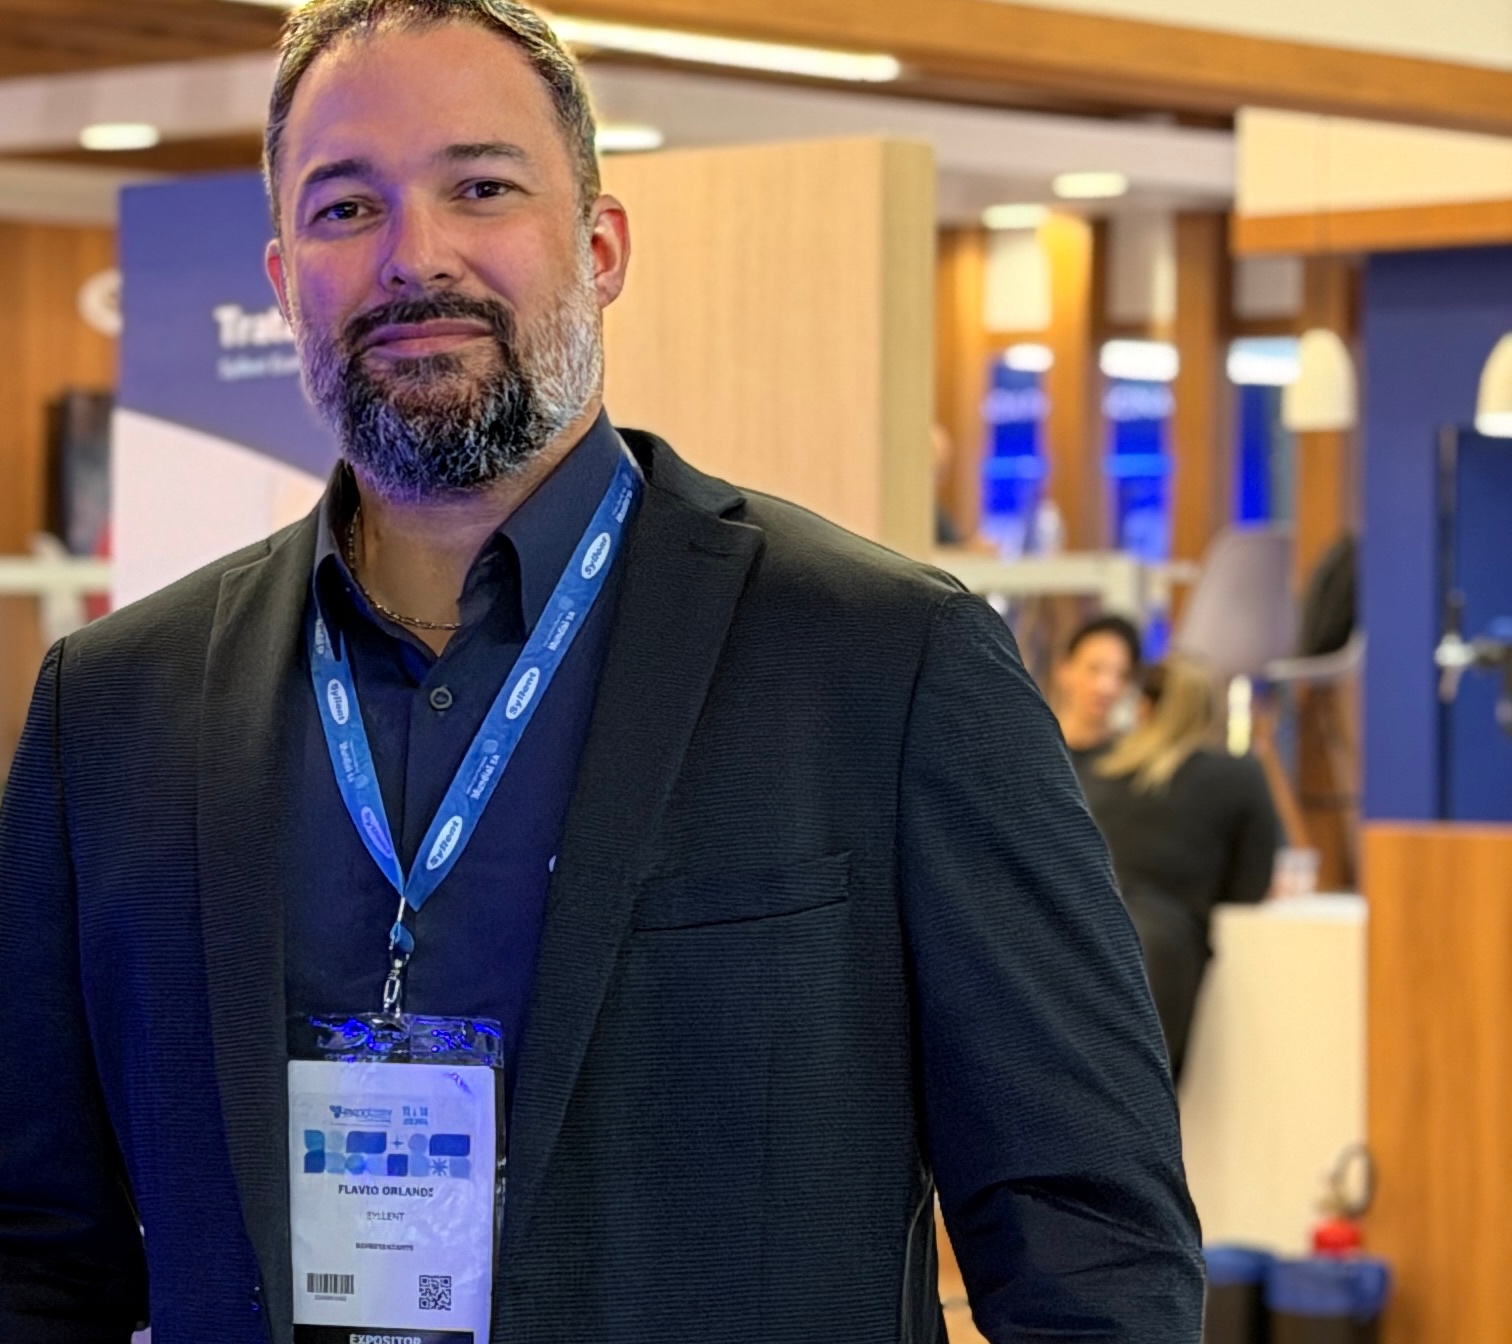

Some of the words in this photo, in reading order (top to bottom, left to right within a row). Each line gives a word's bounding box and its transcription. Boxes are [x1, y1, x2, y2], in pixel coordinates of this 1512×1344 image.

[330, 682, 345, 721] Syllent
[509, 671, 537, 716] Syllent
[429, 820, 460, 867] Syllent
[338, 1184, 380, 1196] FLAVIO
